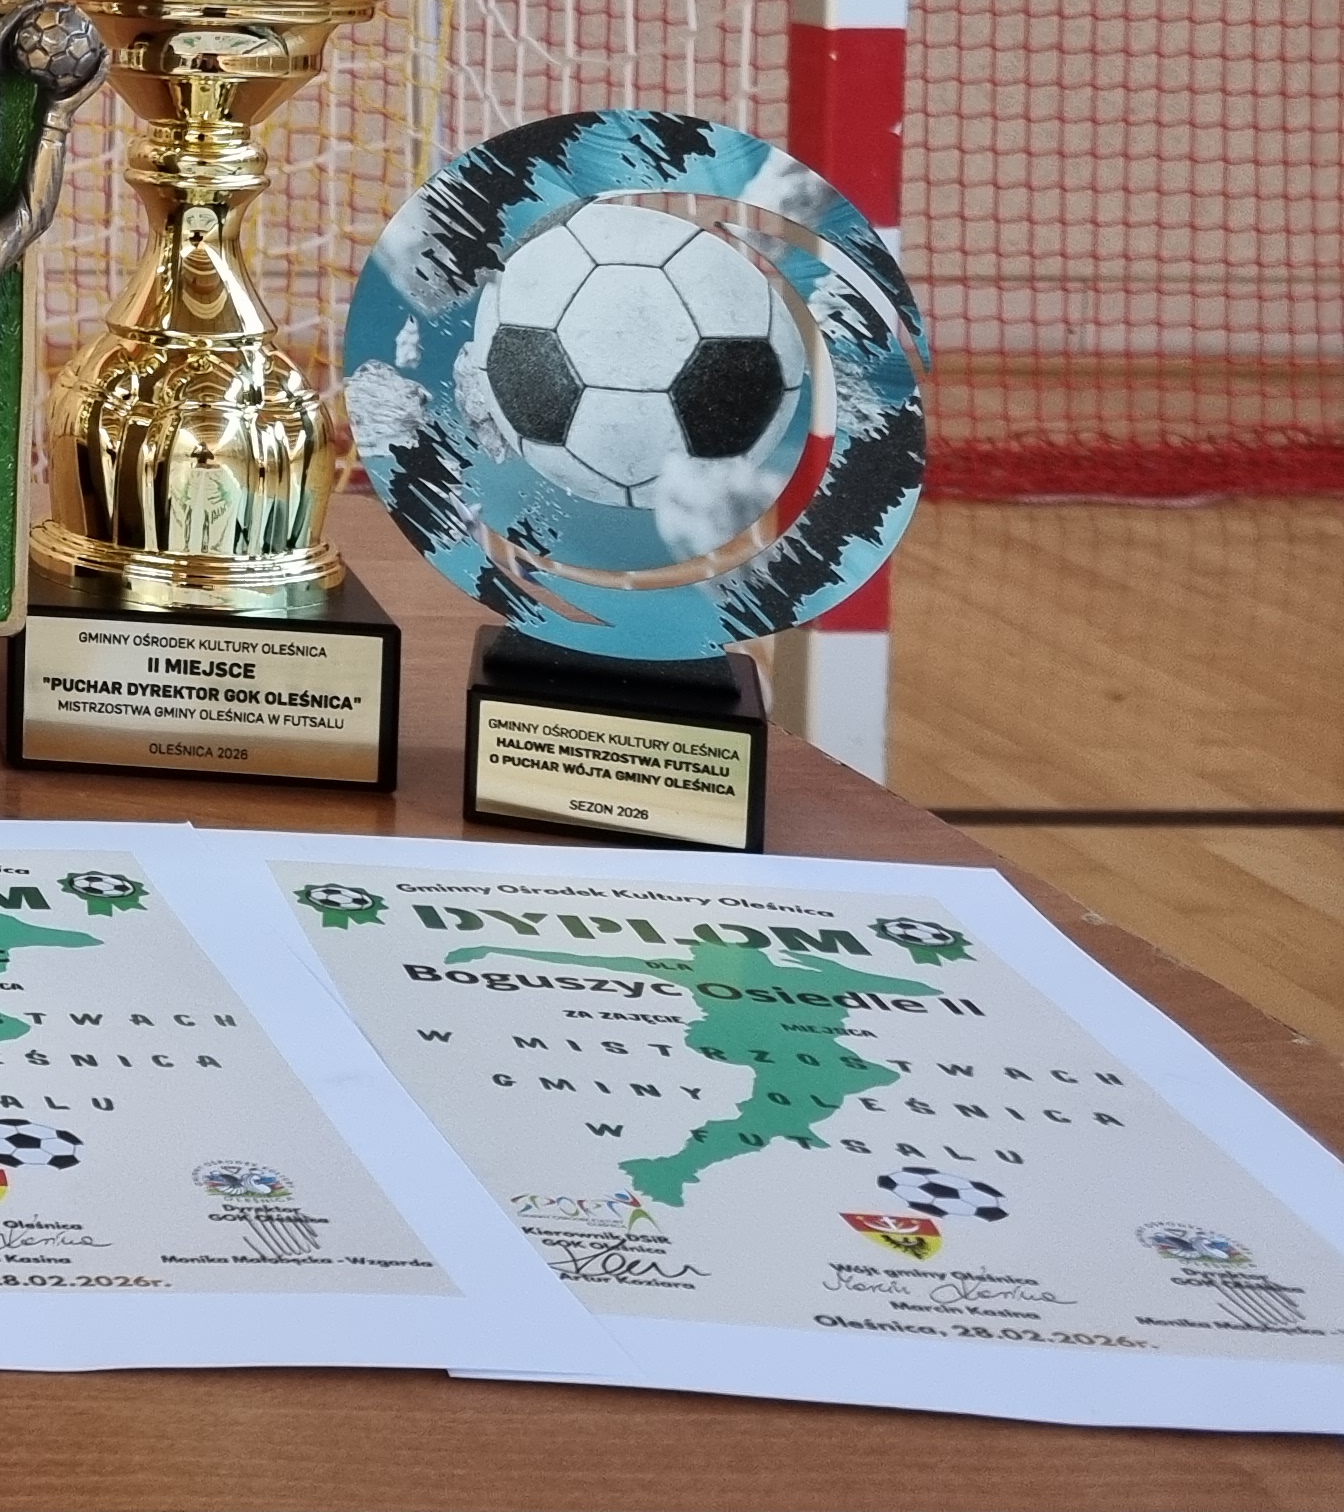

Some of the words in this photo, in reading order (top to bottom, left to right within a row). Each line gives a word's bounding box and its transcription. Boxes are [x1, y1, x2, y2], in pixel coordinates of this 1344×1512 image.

[78, 631, 130, 646] GMINNY
[133, 633, 195, 650] OŚRODEK
[199, 640, 259, 653] KULTURY
[261, 641, 327, 658] OLEŚNICA
[147, 657, 159, 673] II
[165, 658, 256, 679] MIEJSCE
[126, 683, 220, 701] DYREKTOR
[224, 690, 260, 705] GOK
[58, 700, 151, 716] MISTRZOSTWA
[154, 706, 197, 719] GMINY
[200, 706, 263, 724] OLEŚNICA
[266, 713, 281, 725] W
[284, 714, 344, 729] FUTSALU
[149, 742, 213, 758] OLEŚNICA
[218, 747, 248, 760] 2026
[488, 718, 539, 736] GMINNY
[542, 724, 605, 743] OŚRODEK
[609, 734, 670, 751] KULTURY
[672, 741, 740, 760] OLEŚNICA
[496, 737, 555, 754] HALOWE
[558, 745, 661, 768] MISTRZOSTWA
[664, 760, 730, 777] FUTSALU
[489, 754, 499, 764] O
[502, 755, 559, 772] PUCHAR
[562, 763, 612, 779] WÓJTA
[615, 771, 661, 786] GMINY
[664, 777, 735, 796] OLEŚNICA
[569, 800, 613, 814] SEZON
[396, 882, 491, 896] Gminny
[497, 884, 607, 899] Ośrodek
[611, 888, 713, 907] Kultury
[718, 896, 834, 918] Oleśnica
[411, 904, 872, 956] DYPLOM
[402, 962, 684, 999] Boguszyc
[696, 982, 928, 1016] Osiedle
[417, 1029, 453, 1043] W
[512, 1036, 1124, 1086] MISTRZOSTWACH
[492, 1073, 701, 1100] GMINY
[767, 1092, 1125, 1127] OLEŚNICA
[585, 1122, 624, 1137] W
[690, 1129, 1024, 1165] FUTSALU
